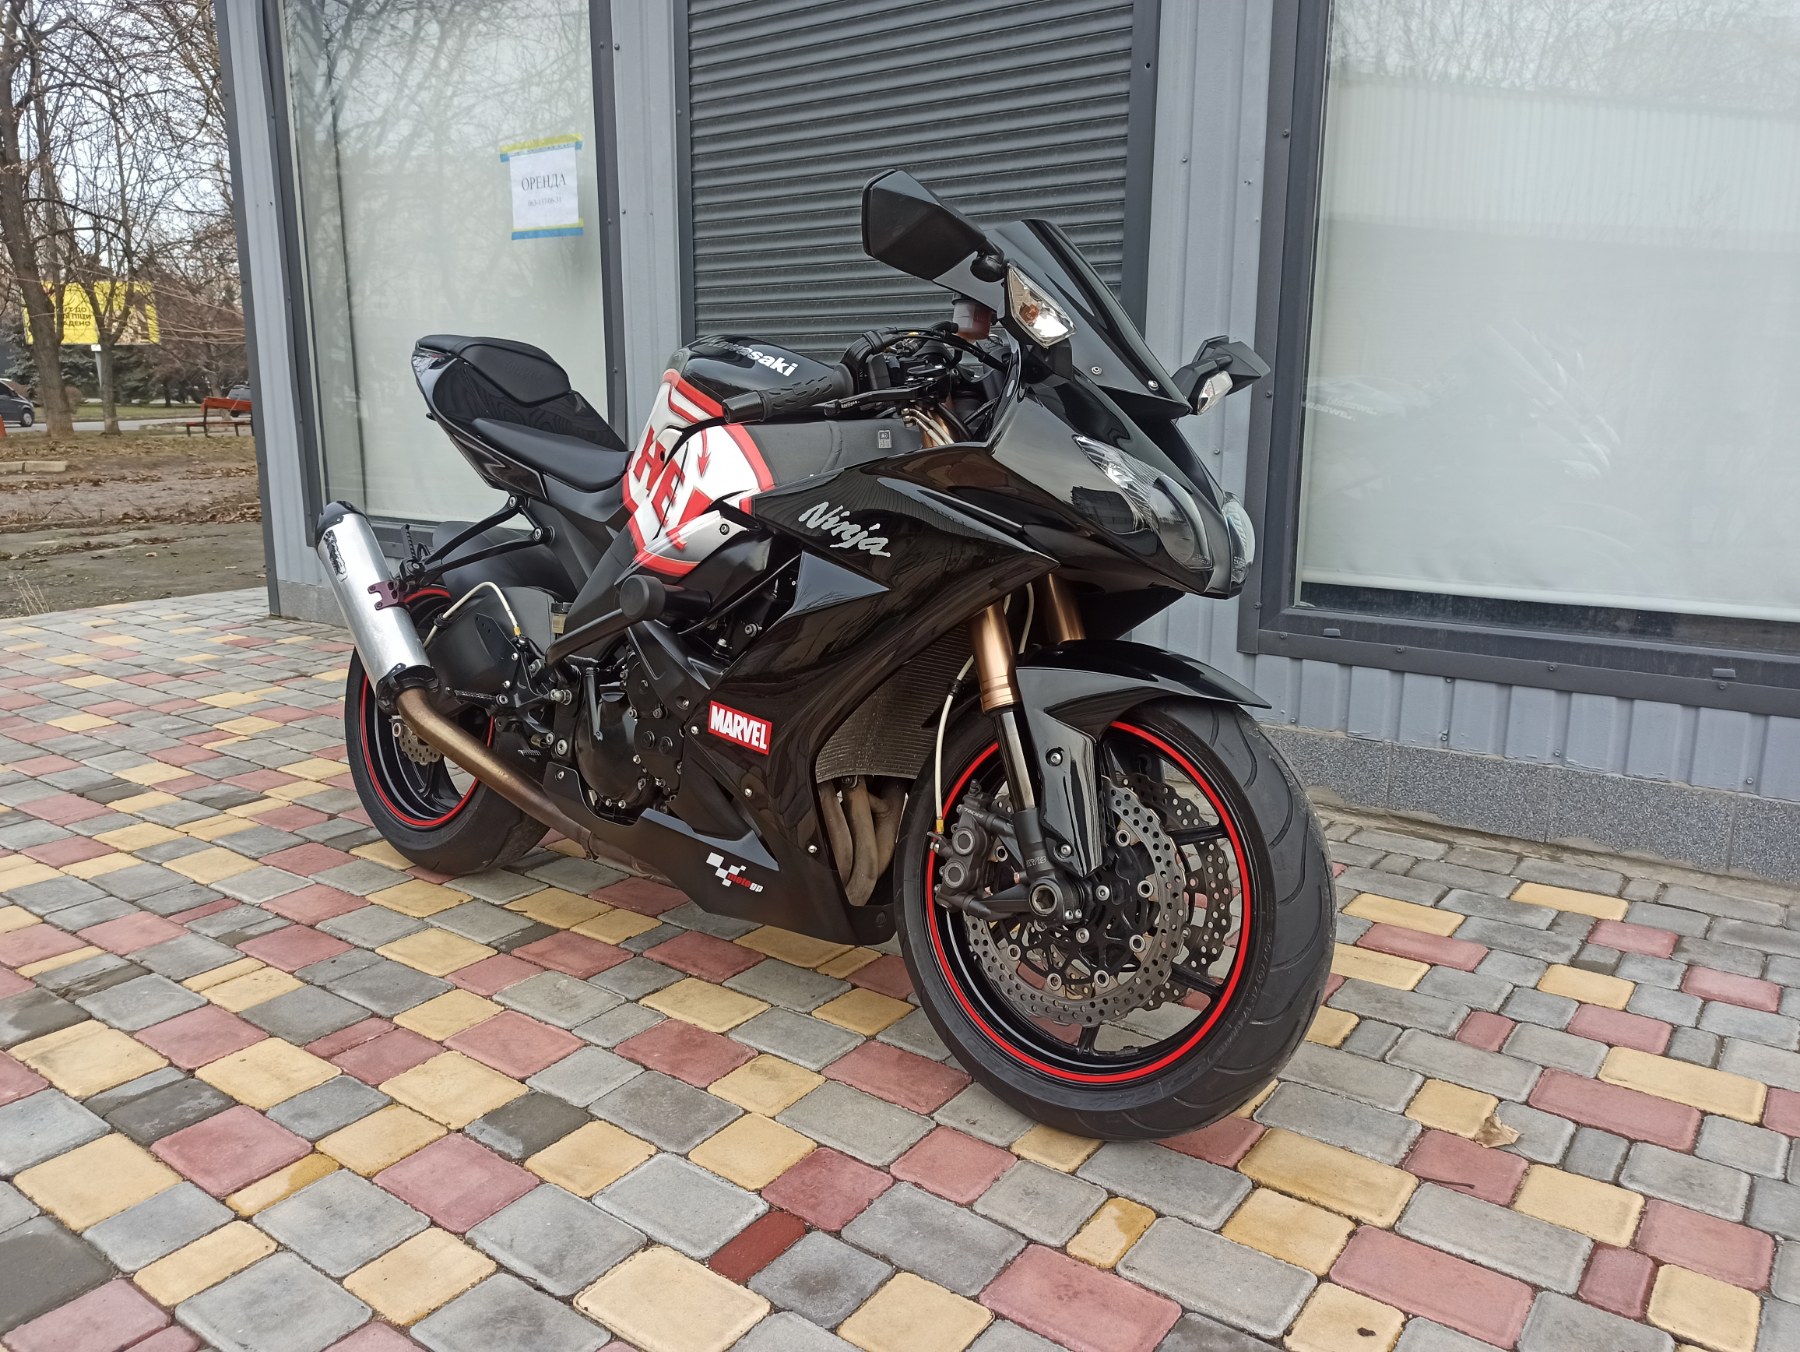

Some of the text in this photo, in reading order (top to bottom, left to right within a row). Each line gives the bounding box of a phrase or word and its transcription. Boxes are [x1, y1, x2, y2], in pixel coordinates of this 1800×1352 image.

[521, 173, 566, 191] ОРЕНДА
[63, 320, 91, 328] АДЕНО
[798, 501, 892, 558] Ninja
[710, 705, 768, 750] MARVEL
